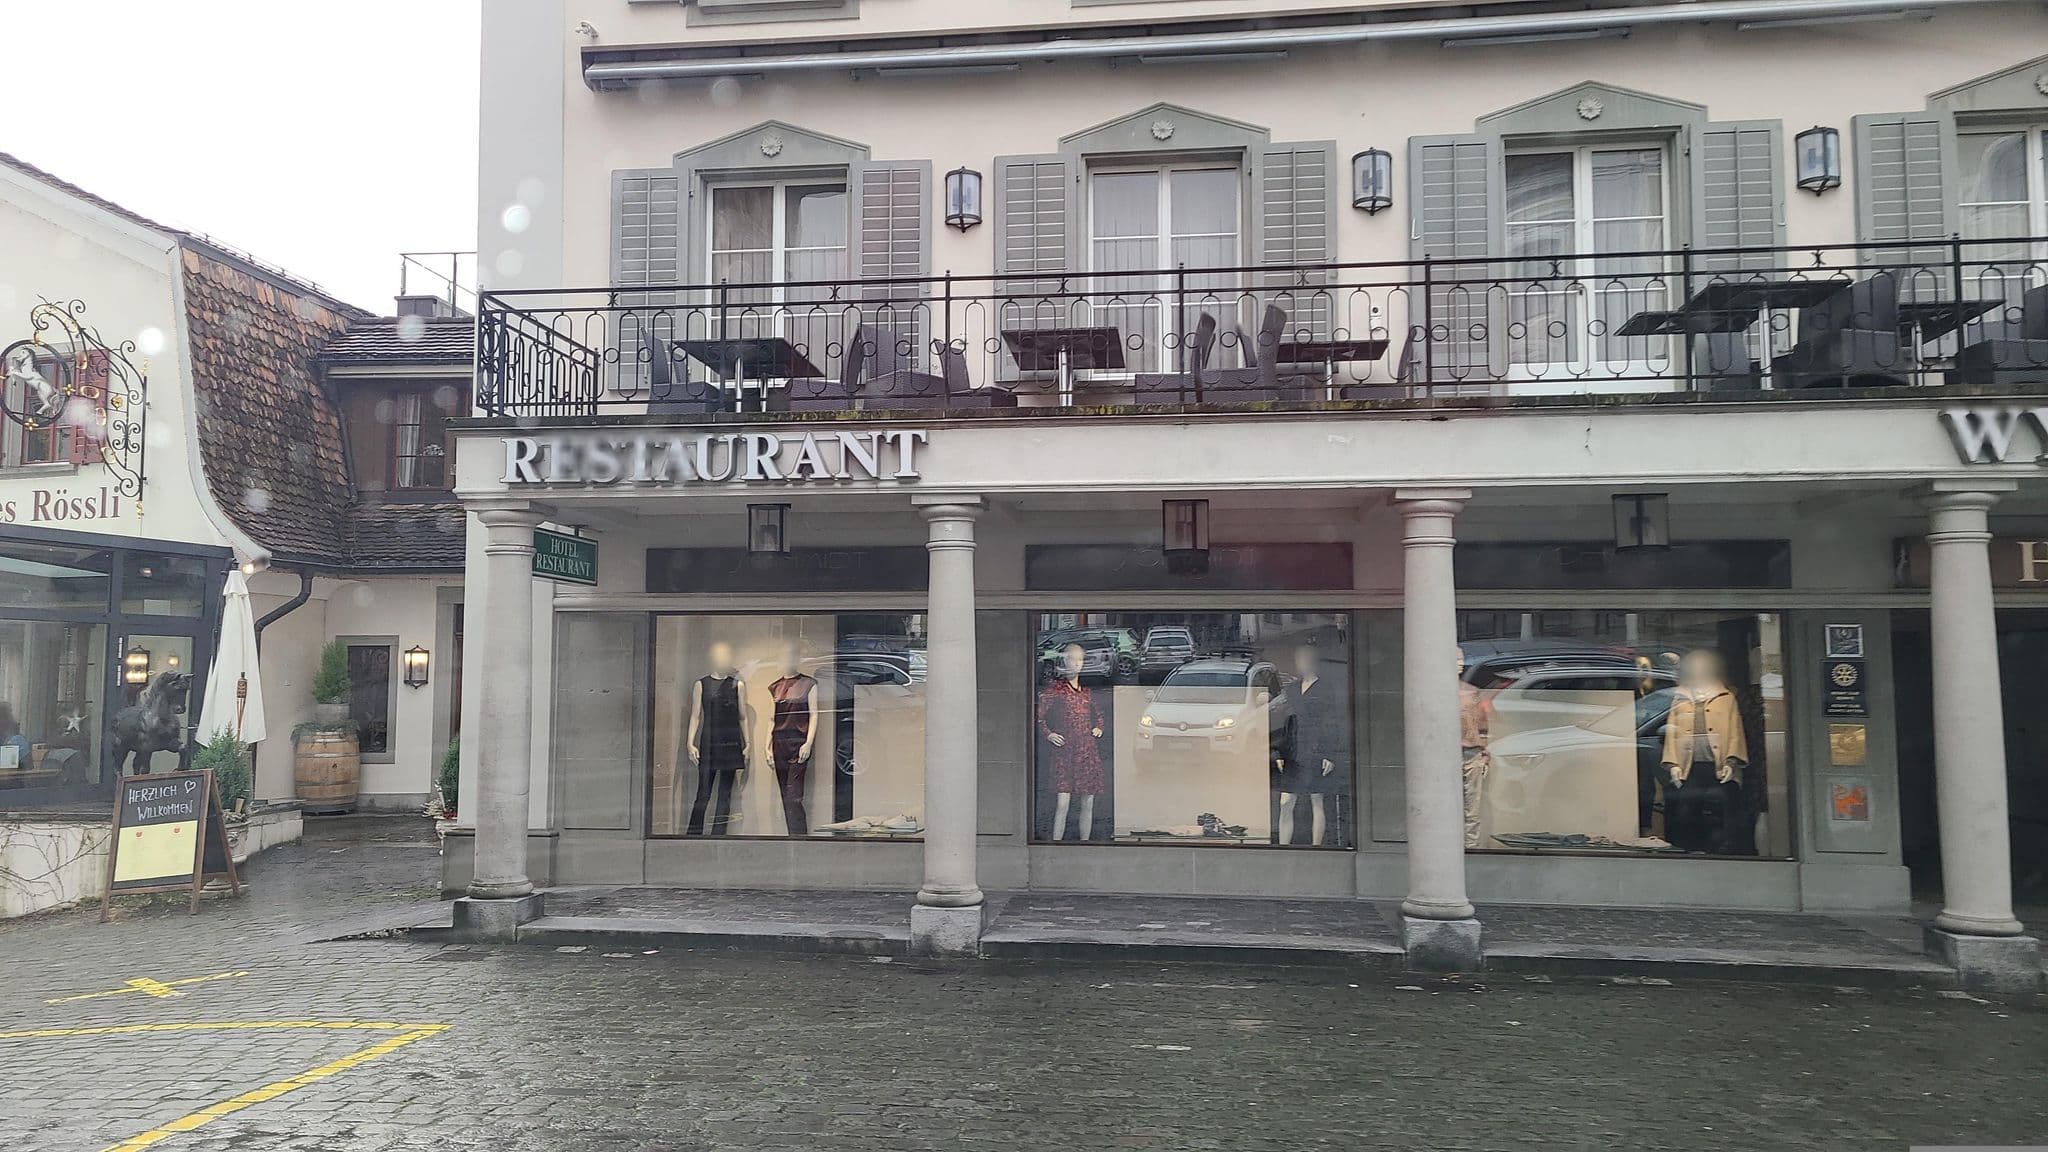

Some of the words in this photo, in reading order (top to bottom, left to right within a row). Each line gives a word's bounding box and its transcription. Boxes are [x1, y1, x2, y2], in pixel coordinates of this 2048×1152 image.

[500, 429, 927, 483] RESTAURANT
[30, 486, 120, 521] Rössli
[551, 538, 579, 558] HOTEL
[536, 552, 591, 577] RESTAURANT
[128, 785, 177, 805] HERZLICH
[137, 799, 194, 821] WILLKOMMEN
